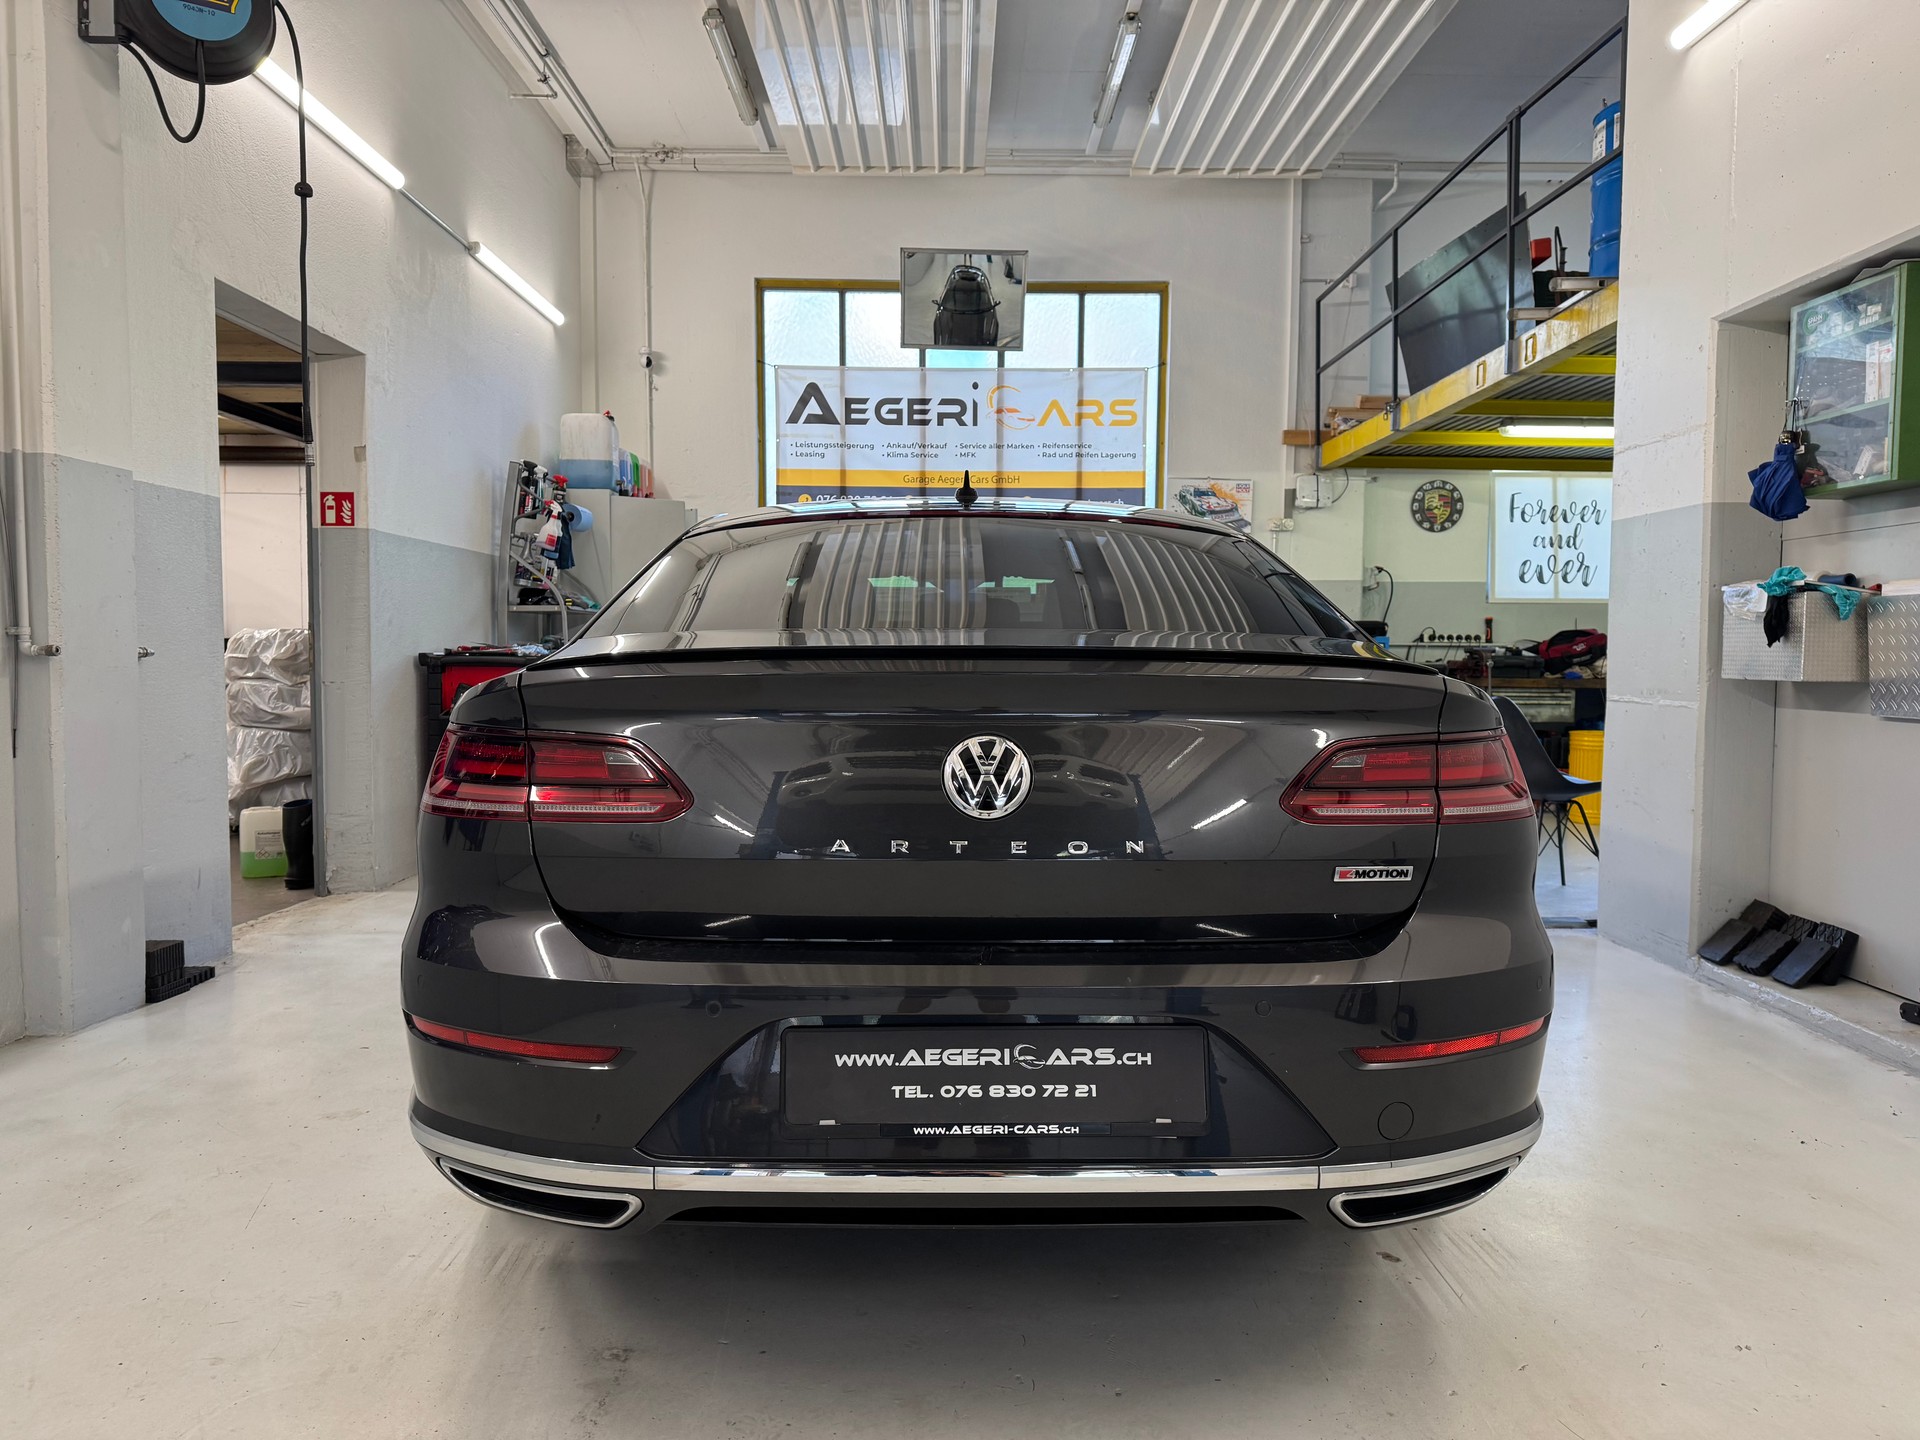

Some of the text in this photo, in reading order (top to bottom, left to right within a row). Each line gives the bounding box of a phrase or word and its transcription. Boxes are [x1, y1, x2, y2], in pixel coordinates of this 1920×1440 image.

[795, 441, 875, 450] Leistungssteigerung
[886, 442, 948, 450] Ankauf/Verkauf
[959, 442, 1035, 450] Service aller Marken
[1042, 442, 1093, 450] Reifenservice
[795, 450, 826, 459] Leasing
[886, 451, 939, 459] Klima Service
[959, 451, 977, 459] MFK
[1042, 451, 1137, 460] Rad und Reifen Lagerung
[903, 474, 1021, 486] Garage Aeger Cars GmbH
[1509, 492, 1606, 525] Forever
[1533, 523, 1583, 550] and
[1519, 552, 1598, 587] ever
[830, 839, 1144, 854] ARTEON
[891, 1084, 1097, 1098] TEL. 076 830 72 21
